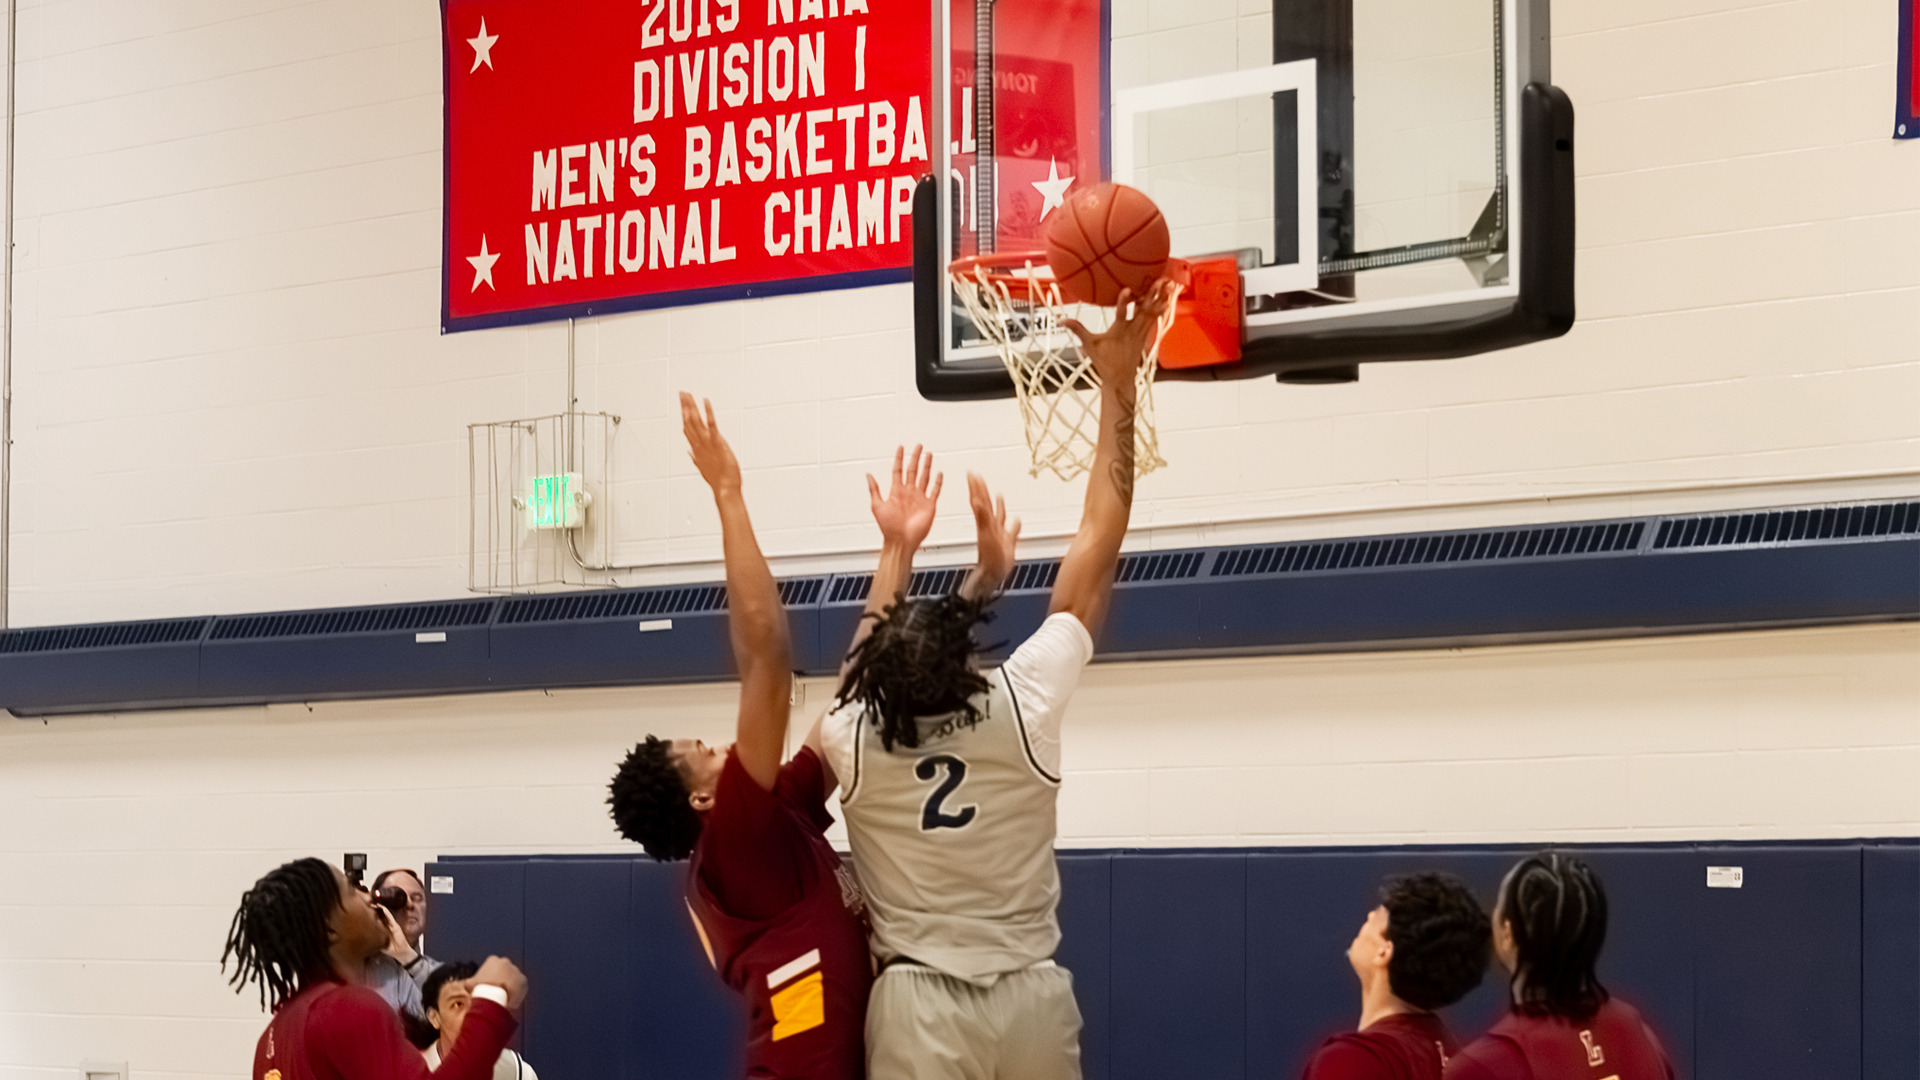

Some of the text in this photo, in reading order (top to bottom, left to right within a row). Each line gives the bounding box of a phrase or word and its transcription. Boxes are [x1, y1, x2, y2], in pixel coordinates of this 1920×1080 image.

[633, 25, 867, 124] DIVISION I
[531, 86, 977, 212] MEN'S BASKETBAL
[525, 162, 999, 286] NATIONAL CHAMP
[533, 475, 570, 526] EXIT
[912, 752, 979, 832] 2
